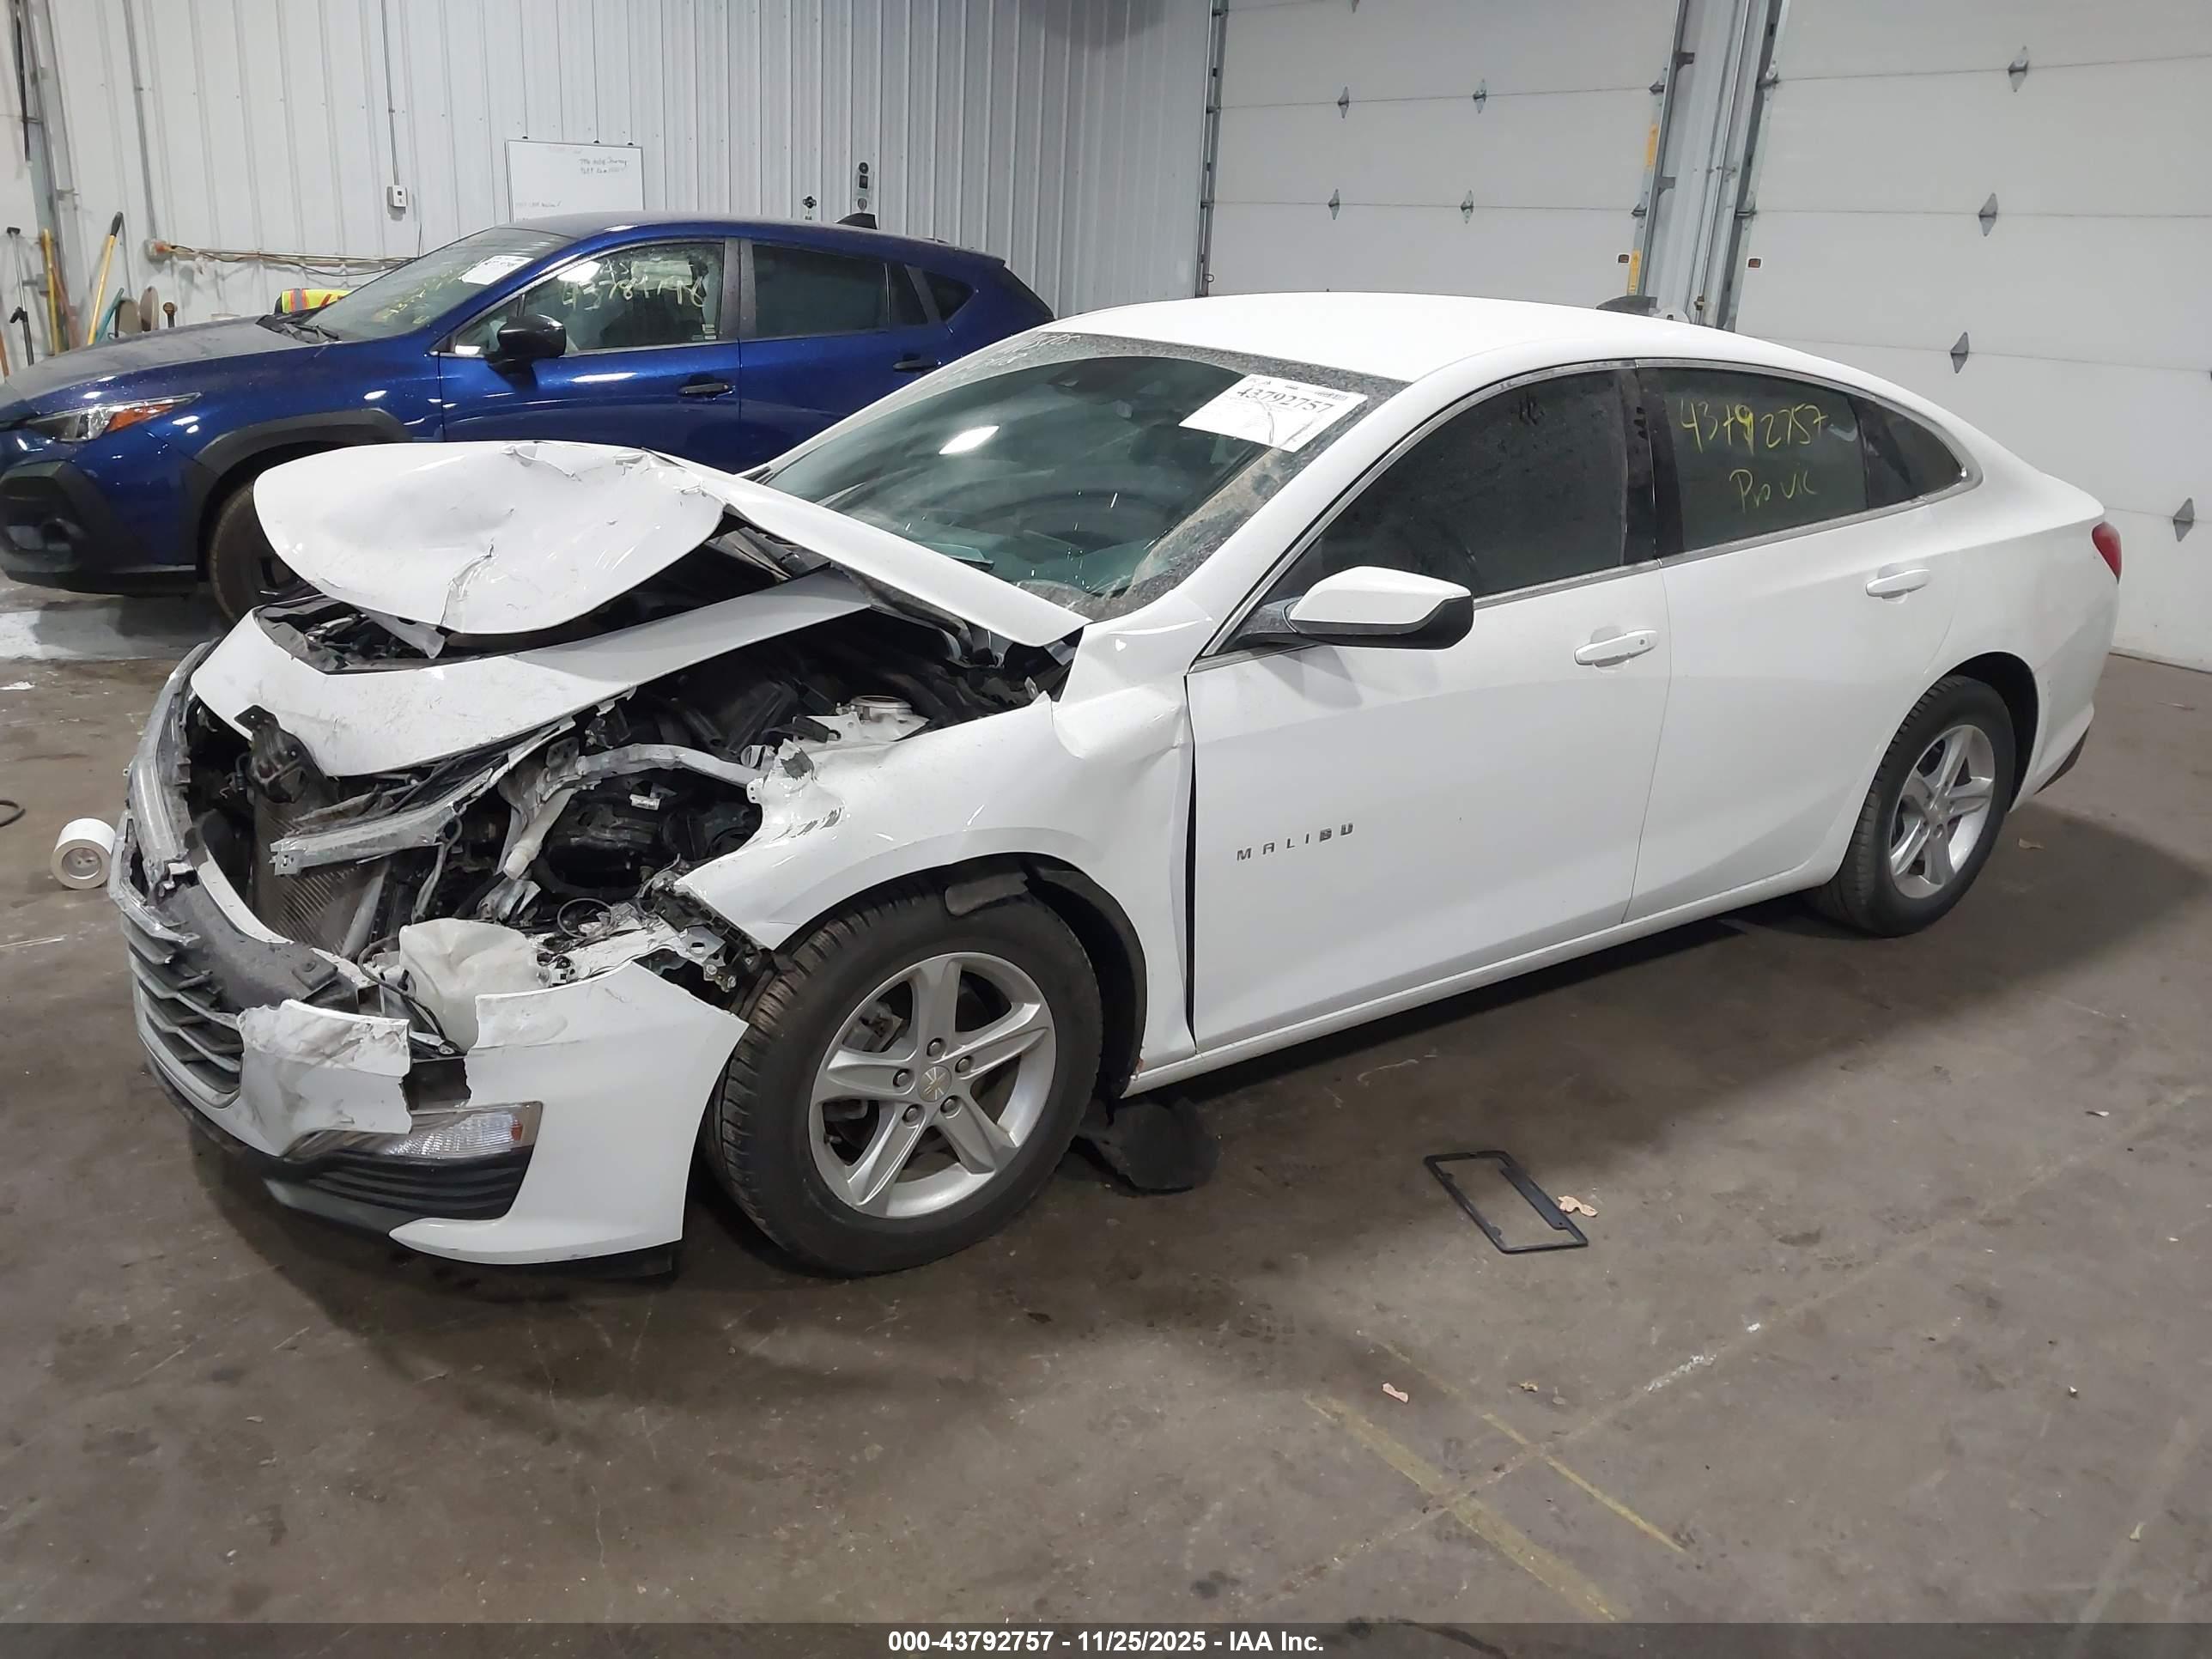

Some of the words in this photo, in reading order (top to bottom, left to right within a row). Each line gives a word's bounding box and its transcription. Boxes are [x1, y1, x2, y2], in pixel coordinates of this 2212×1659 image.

[1237, 387, 1335, 413] 43792757
[1680, 398, 1828, 456] 43792757
[1237, 823, 1354, 861] MALIBU
